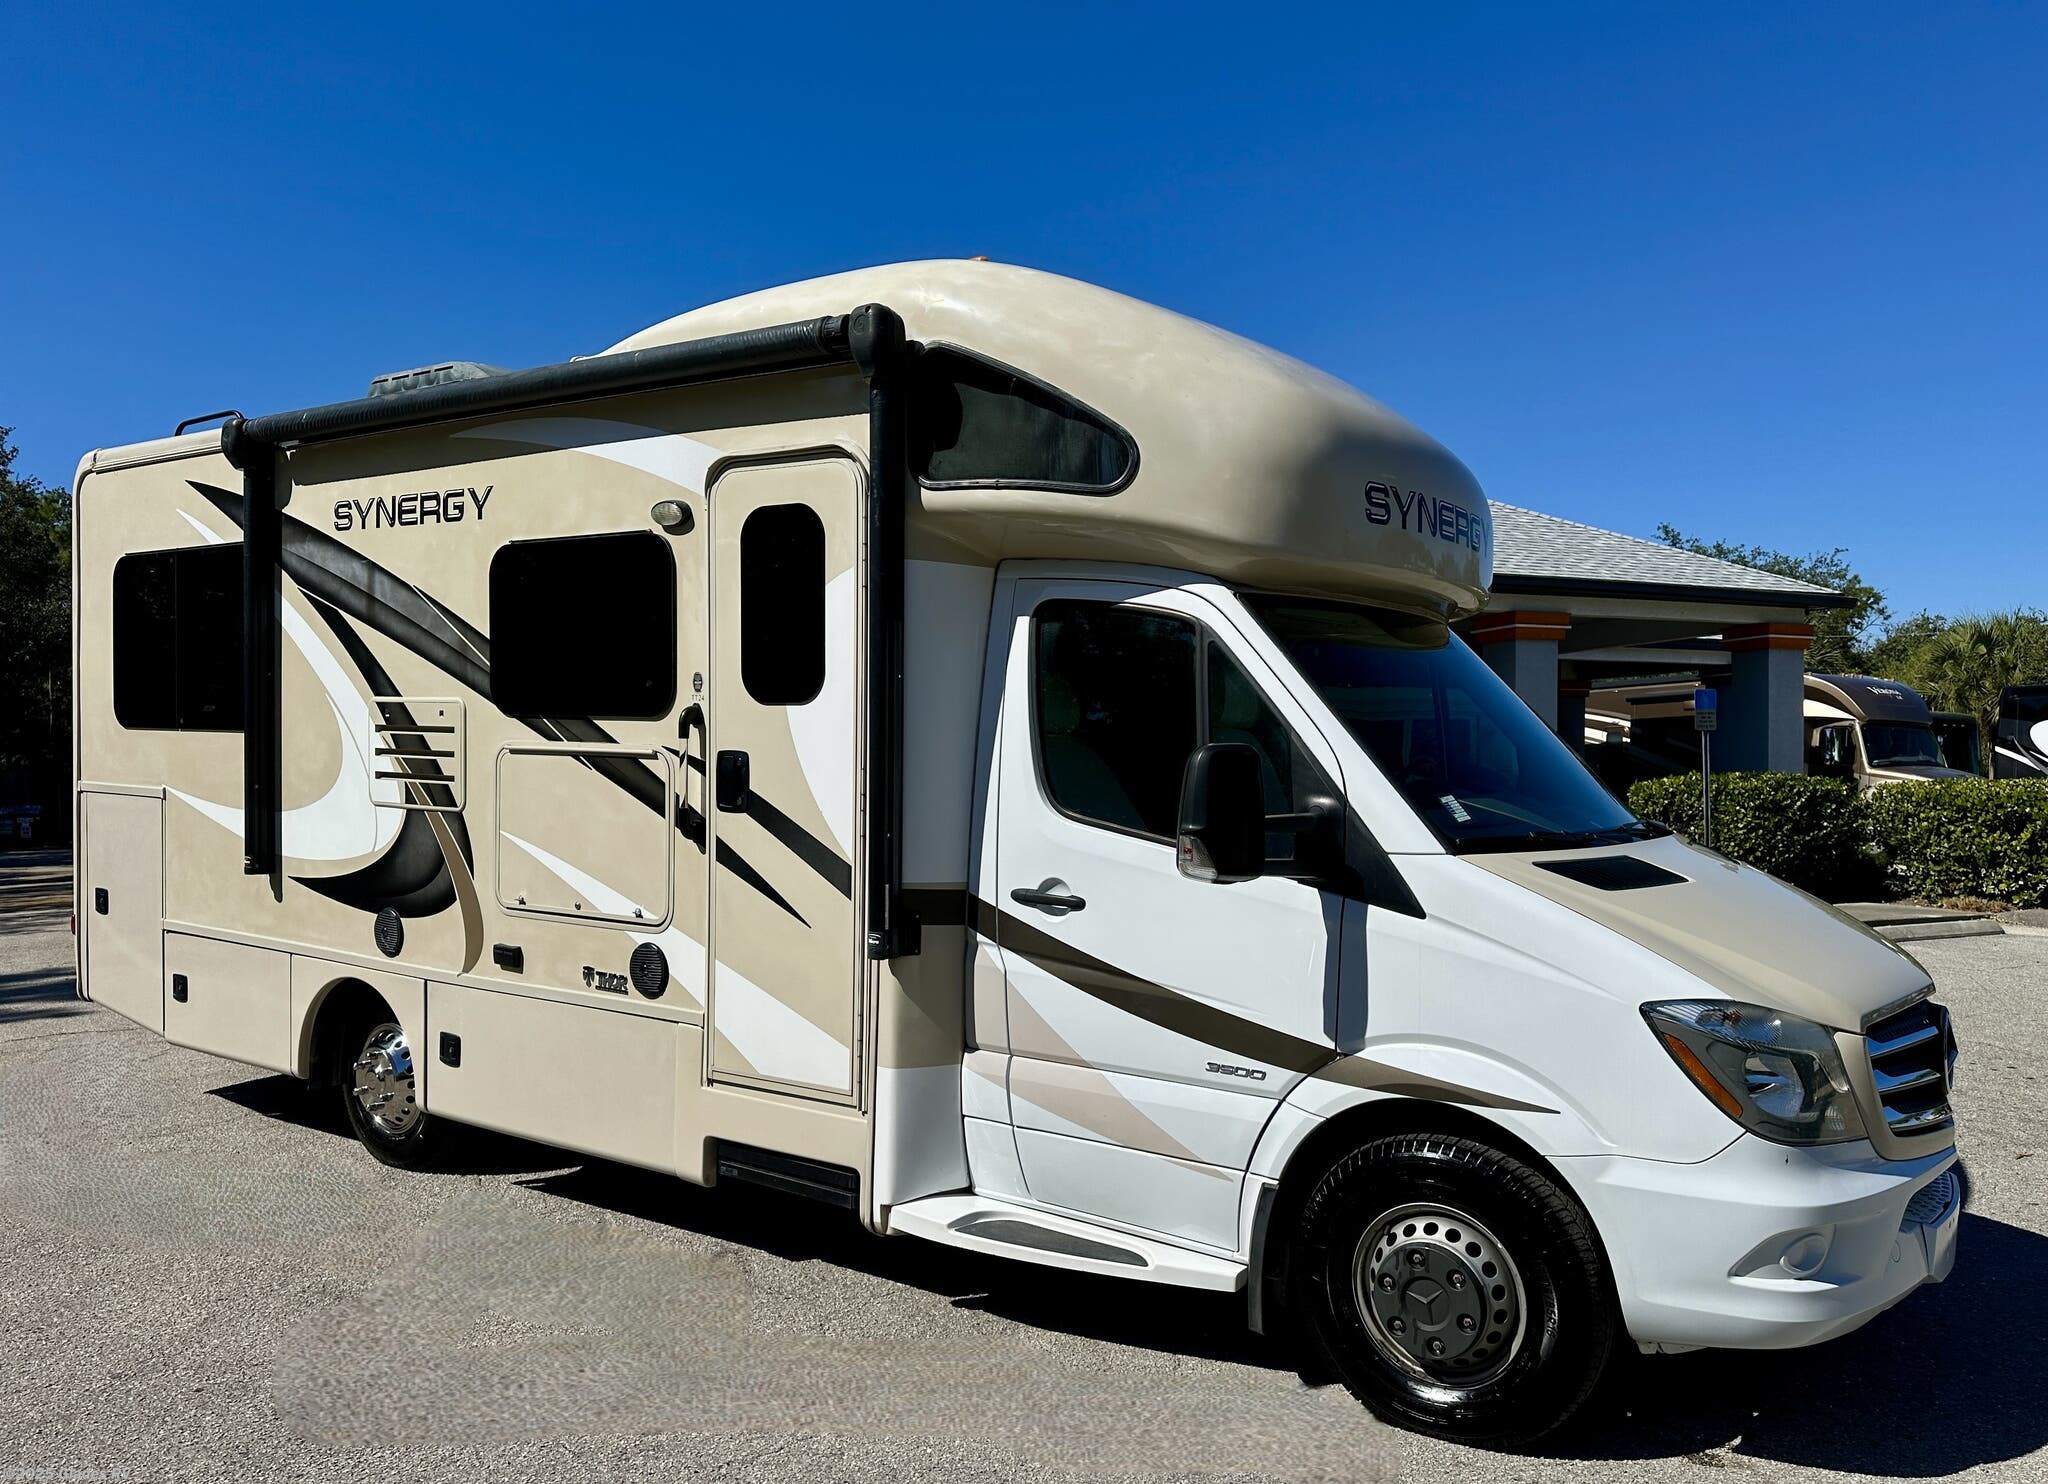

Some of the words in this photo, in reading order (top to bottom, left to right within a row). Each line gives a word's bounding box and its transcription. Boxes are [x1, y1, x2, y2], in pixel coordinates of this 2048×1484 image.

[334, 485, 494, 531] SYNERGY
[1365, 480, 1488, 558] SYNERGY
[1205, 1062, 1267, 1081] 3500
